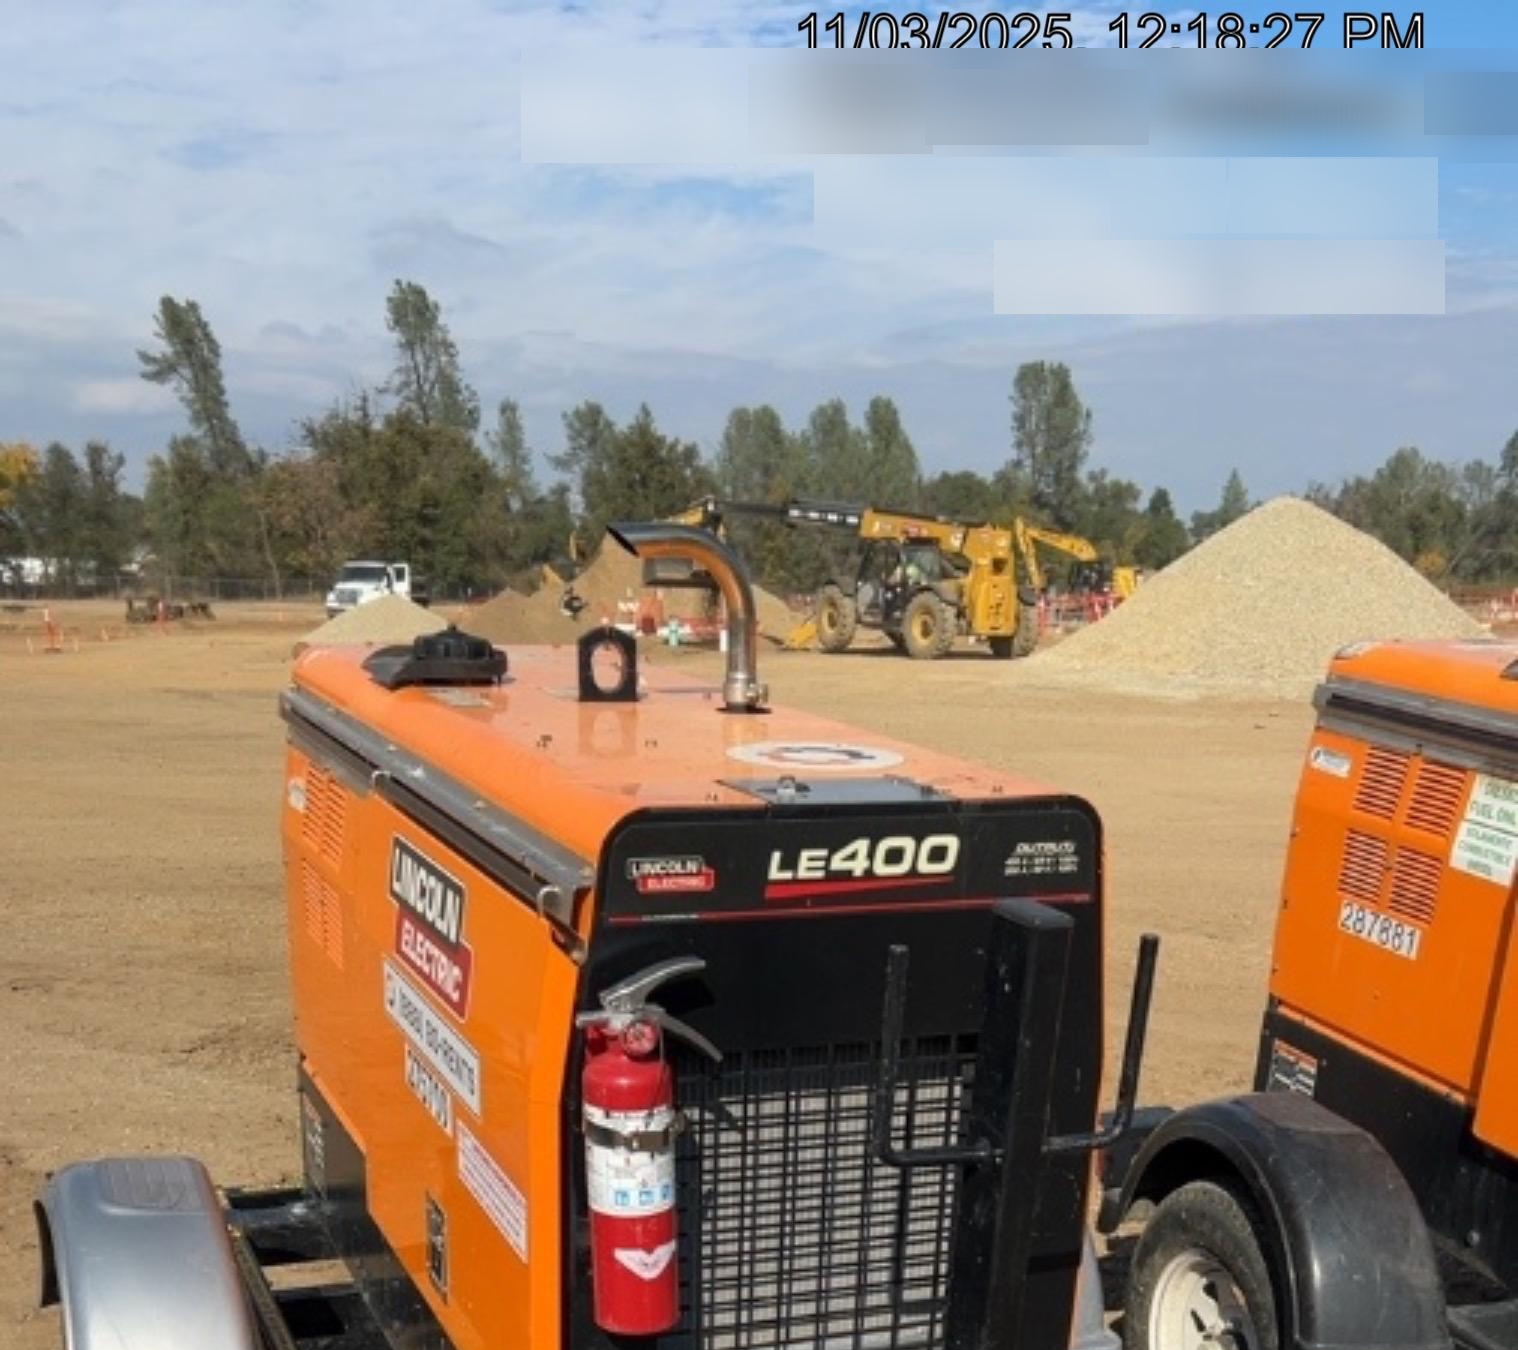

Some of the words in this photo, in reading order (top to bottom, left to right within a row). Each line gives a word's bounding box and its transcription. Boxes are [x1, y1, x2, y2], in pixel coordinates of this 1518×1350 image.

[632, 859, 698, 877] LINCOLN
[768, 834, 960, 880] LE400
[392, 847, 460, 944] LINCOLN
[1340, 901, 1417, 956] 287881
[401, 918, 462, 1003] ELECTRIC
